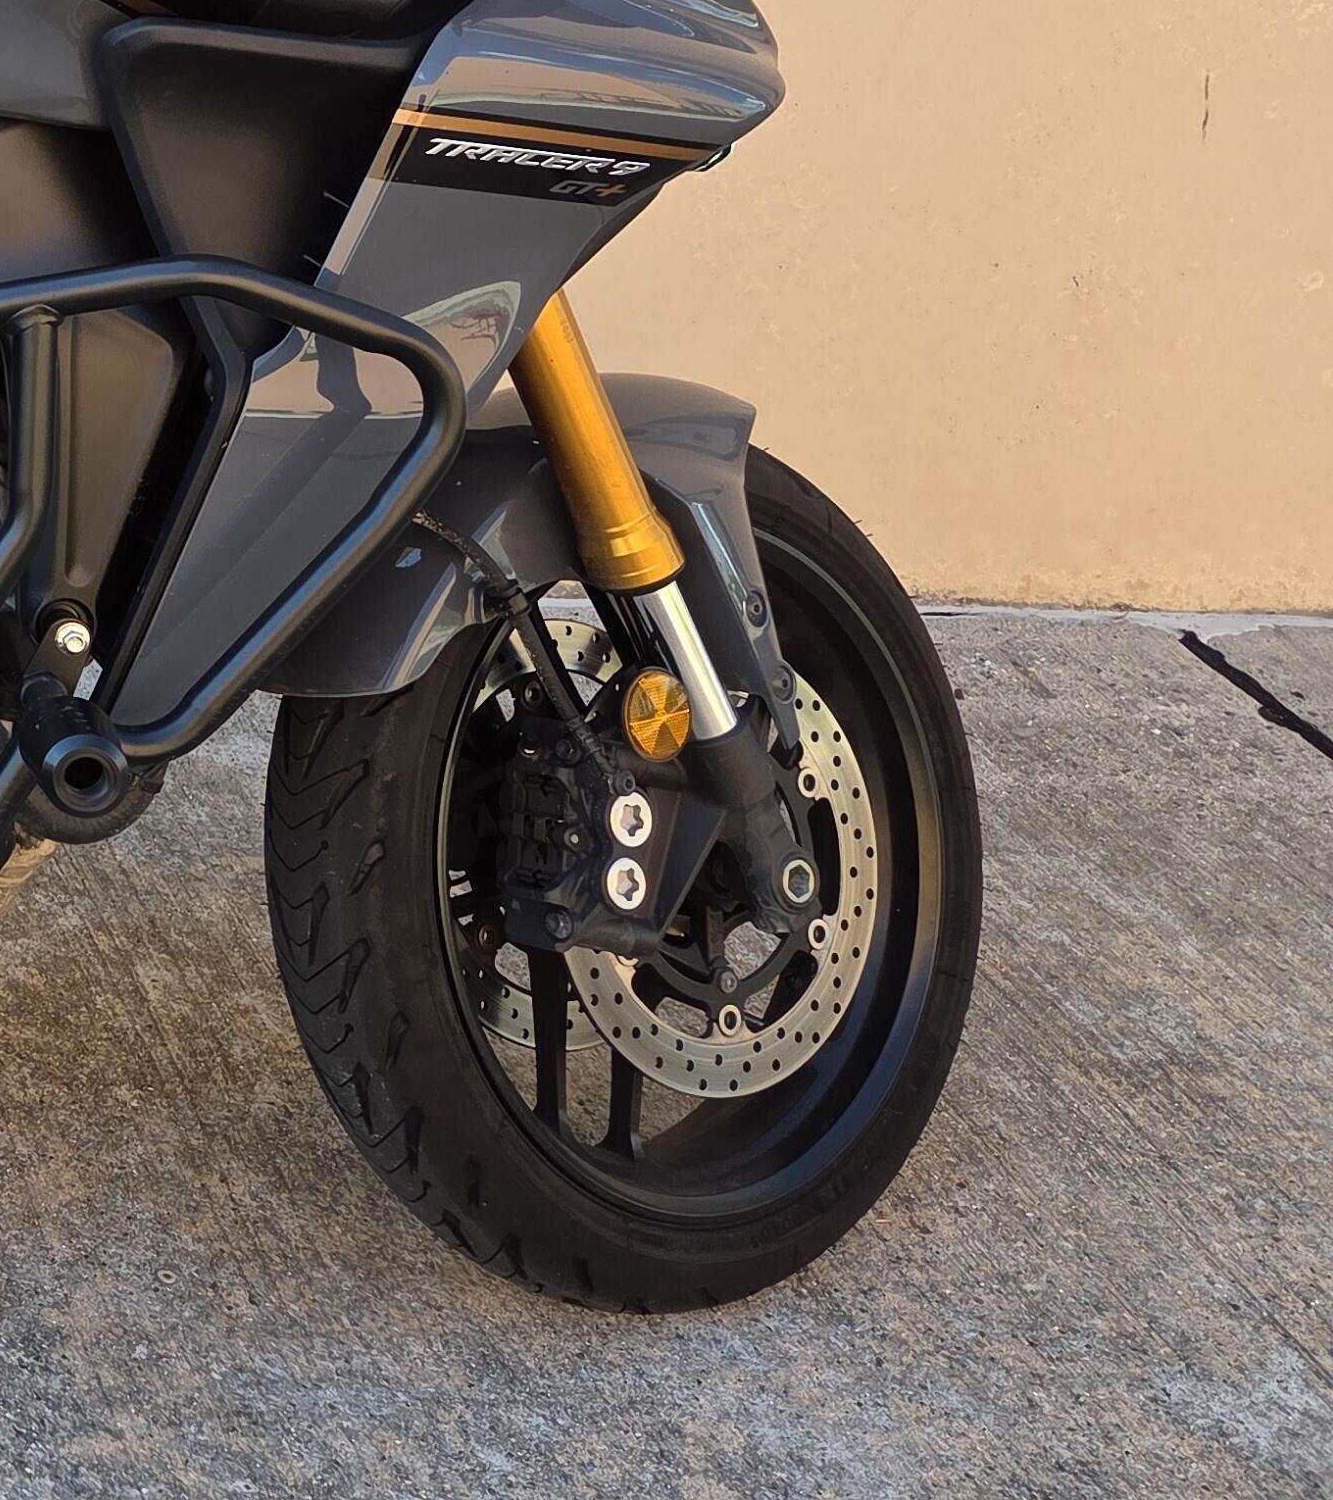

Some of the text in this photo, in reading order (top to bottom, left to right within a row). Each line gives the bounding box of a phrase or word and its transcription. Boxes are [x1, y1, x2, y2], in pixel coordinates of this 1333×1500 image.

[425, 138, 651, 176] TRACER 9
[549, 179, 626, 197] GT+
